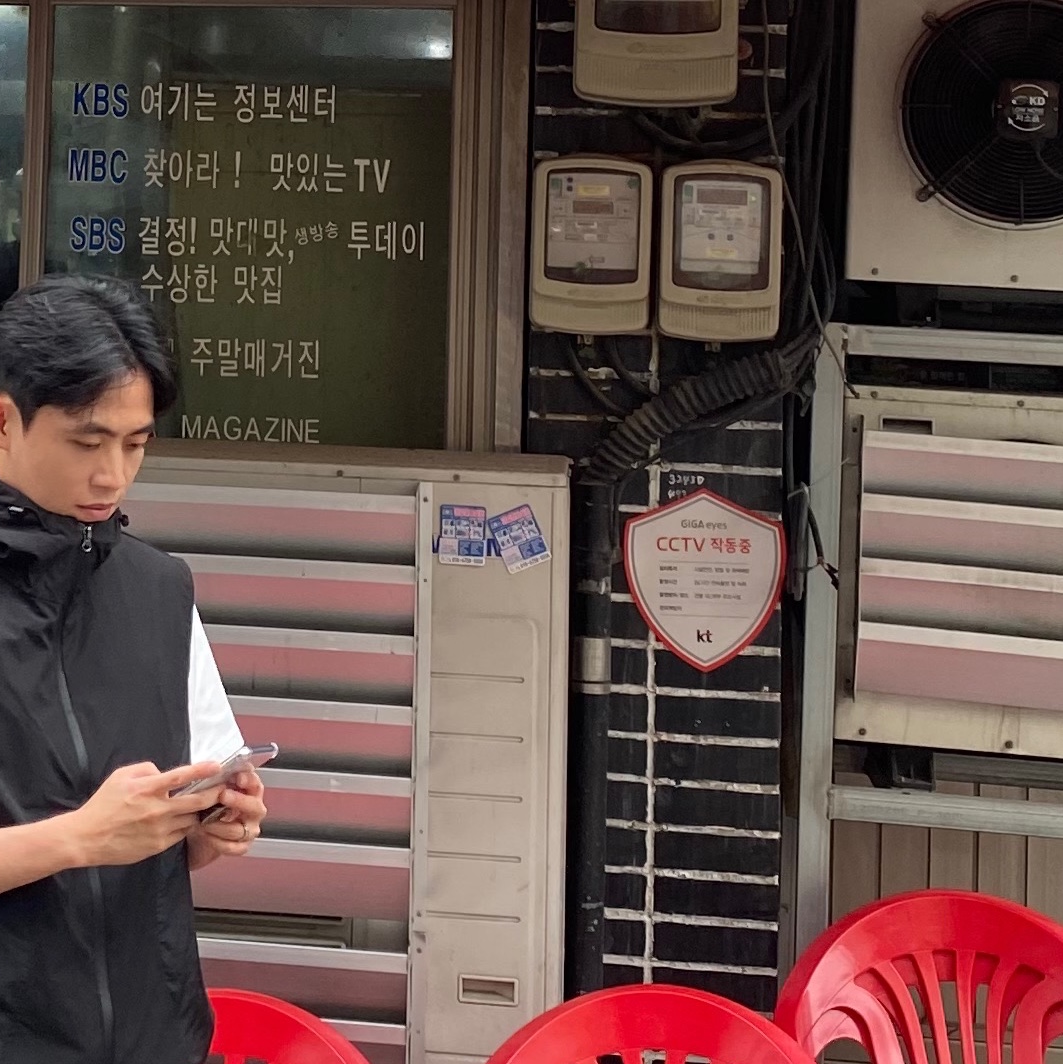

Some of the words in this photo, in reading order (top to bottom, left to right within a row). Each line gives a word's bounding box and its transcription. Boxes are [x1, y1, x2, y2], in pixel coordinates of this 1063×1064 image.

[72, 82, 130, 119] KBS
[140, 83, 218, 123] 여기는
[233, 83, 338, 125] 정보센터
[68, 147, 129, 185] MBC
[69, 215, 126, 254] SBS
[138, 216, 198, 256] 결정!
[347, 220, 426, 261] 투데이
[140, 264, 219, 304] 수상한
[233, 265, 284, 305] 맛집
[190, 337, 321, 379] 주말매거진
[181, 414, 321, 445] MAGAZINE
[705, 520, 728, 532] eyes
[656, 536, 706, 552] CCTV
[709, 537, 752, 555] 작동중
[697, 629, 713, 643] kt
